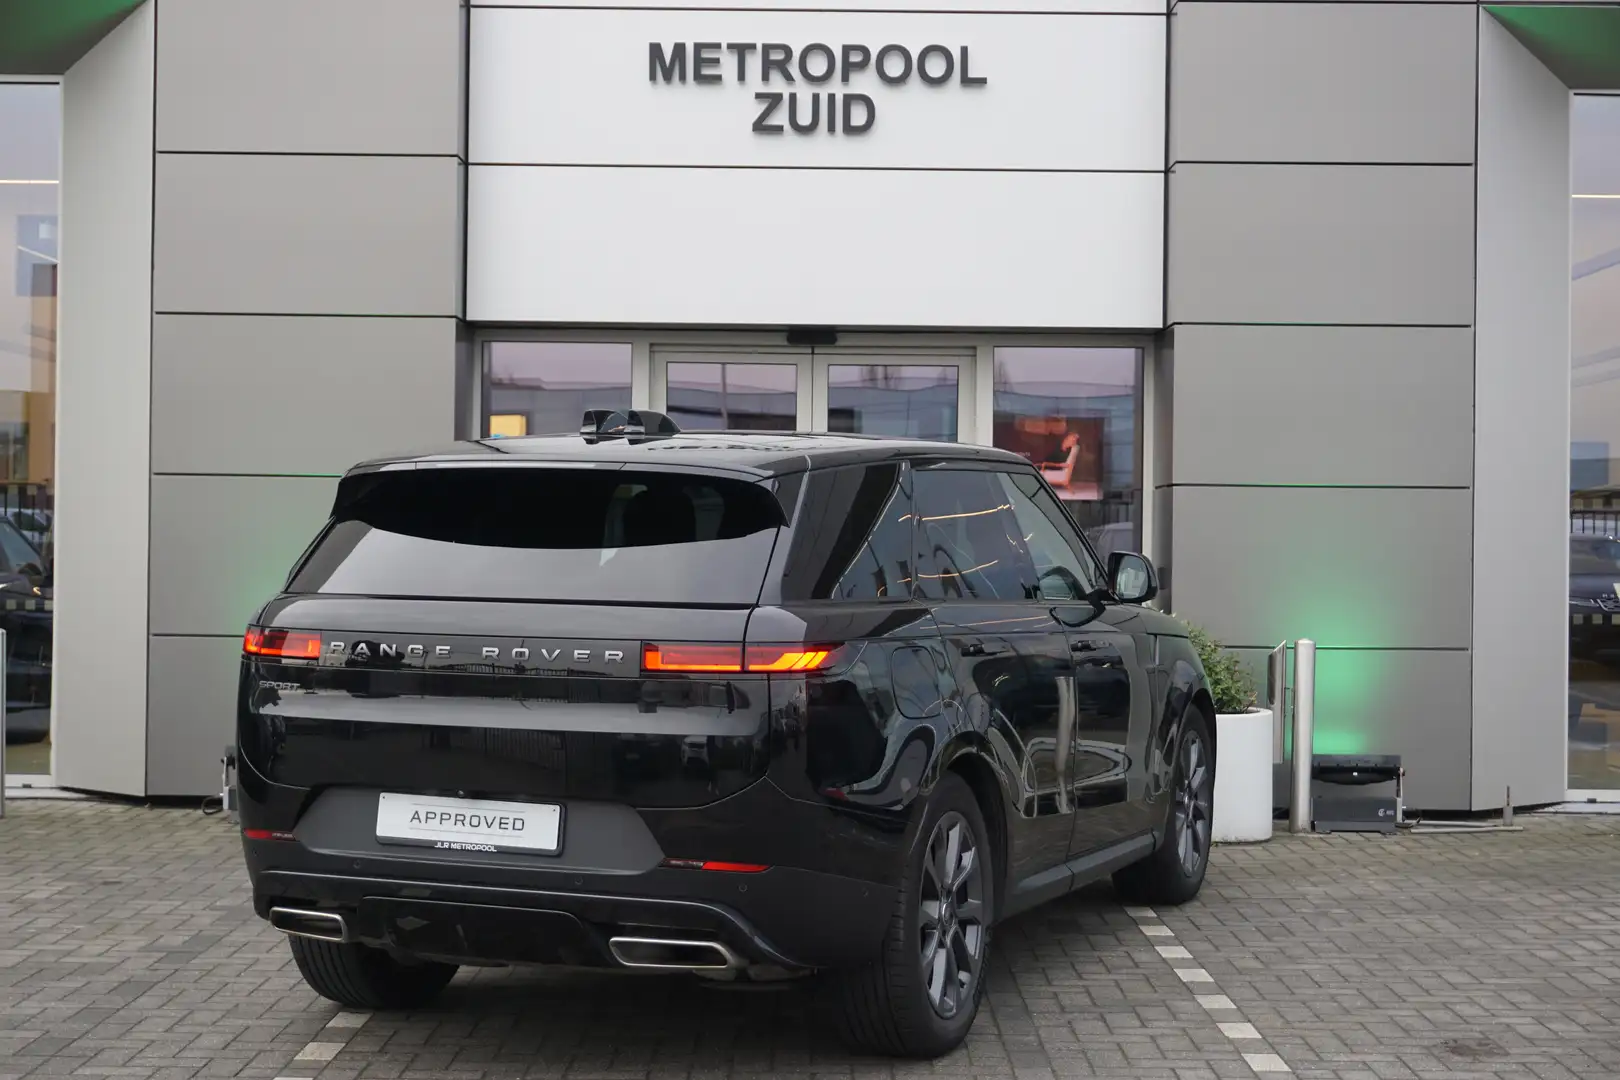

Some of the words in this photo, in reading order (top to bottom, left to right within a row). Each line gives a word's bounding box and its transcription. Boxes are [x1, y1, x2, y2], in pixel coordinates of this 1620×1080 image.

[648, 42, 988, 85] METROPOOL
[752, 92, 876, 134] ZUID
[328, 641, 452, 659] RANGE
[482, 646, 625, 664] ROVER
[259, 680, 301, 691] SPORT
[409, 810, 526, 832] APPROVED
[434, 841, 449, 850] JLR
[450, 843, 498, 853] METROPOOL
